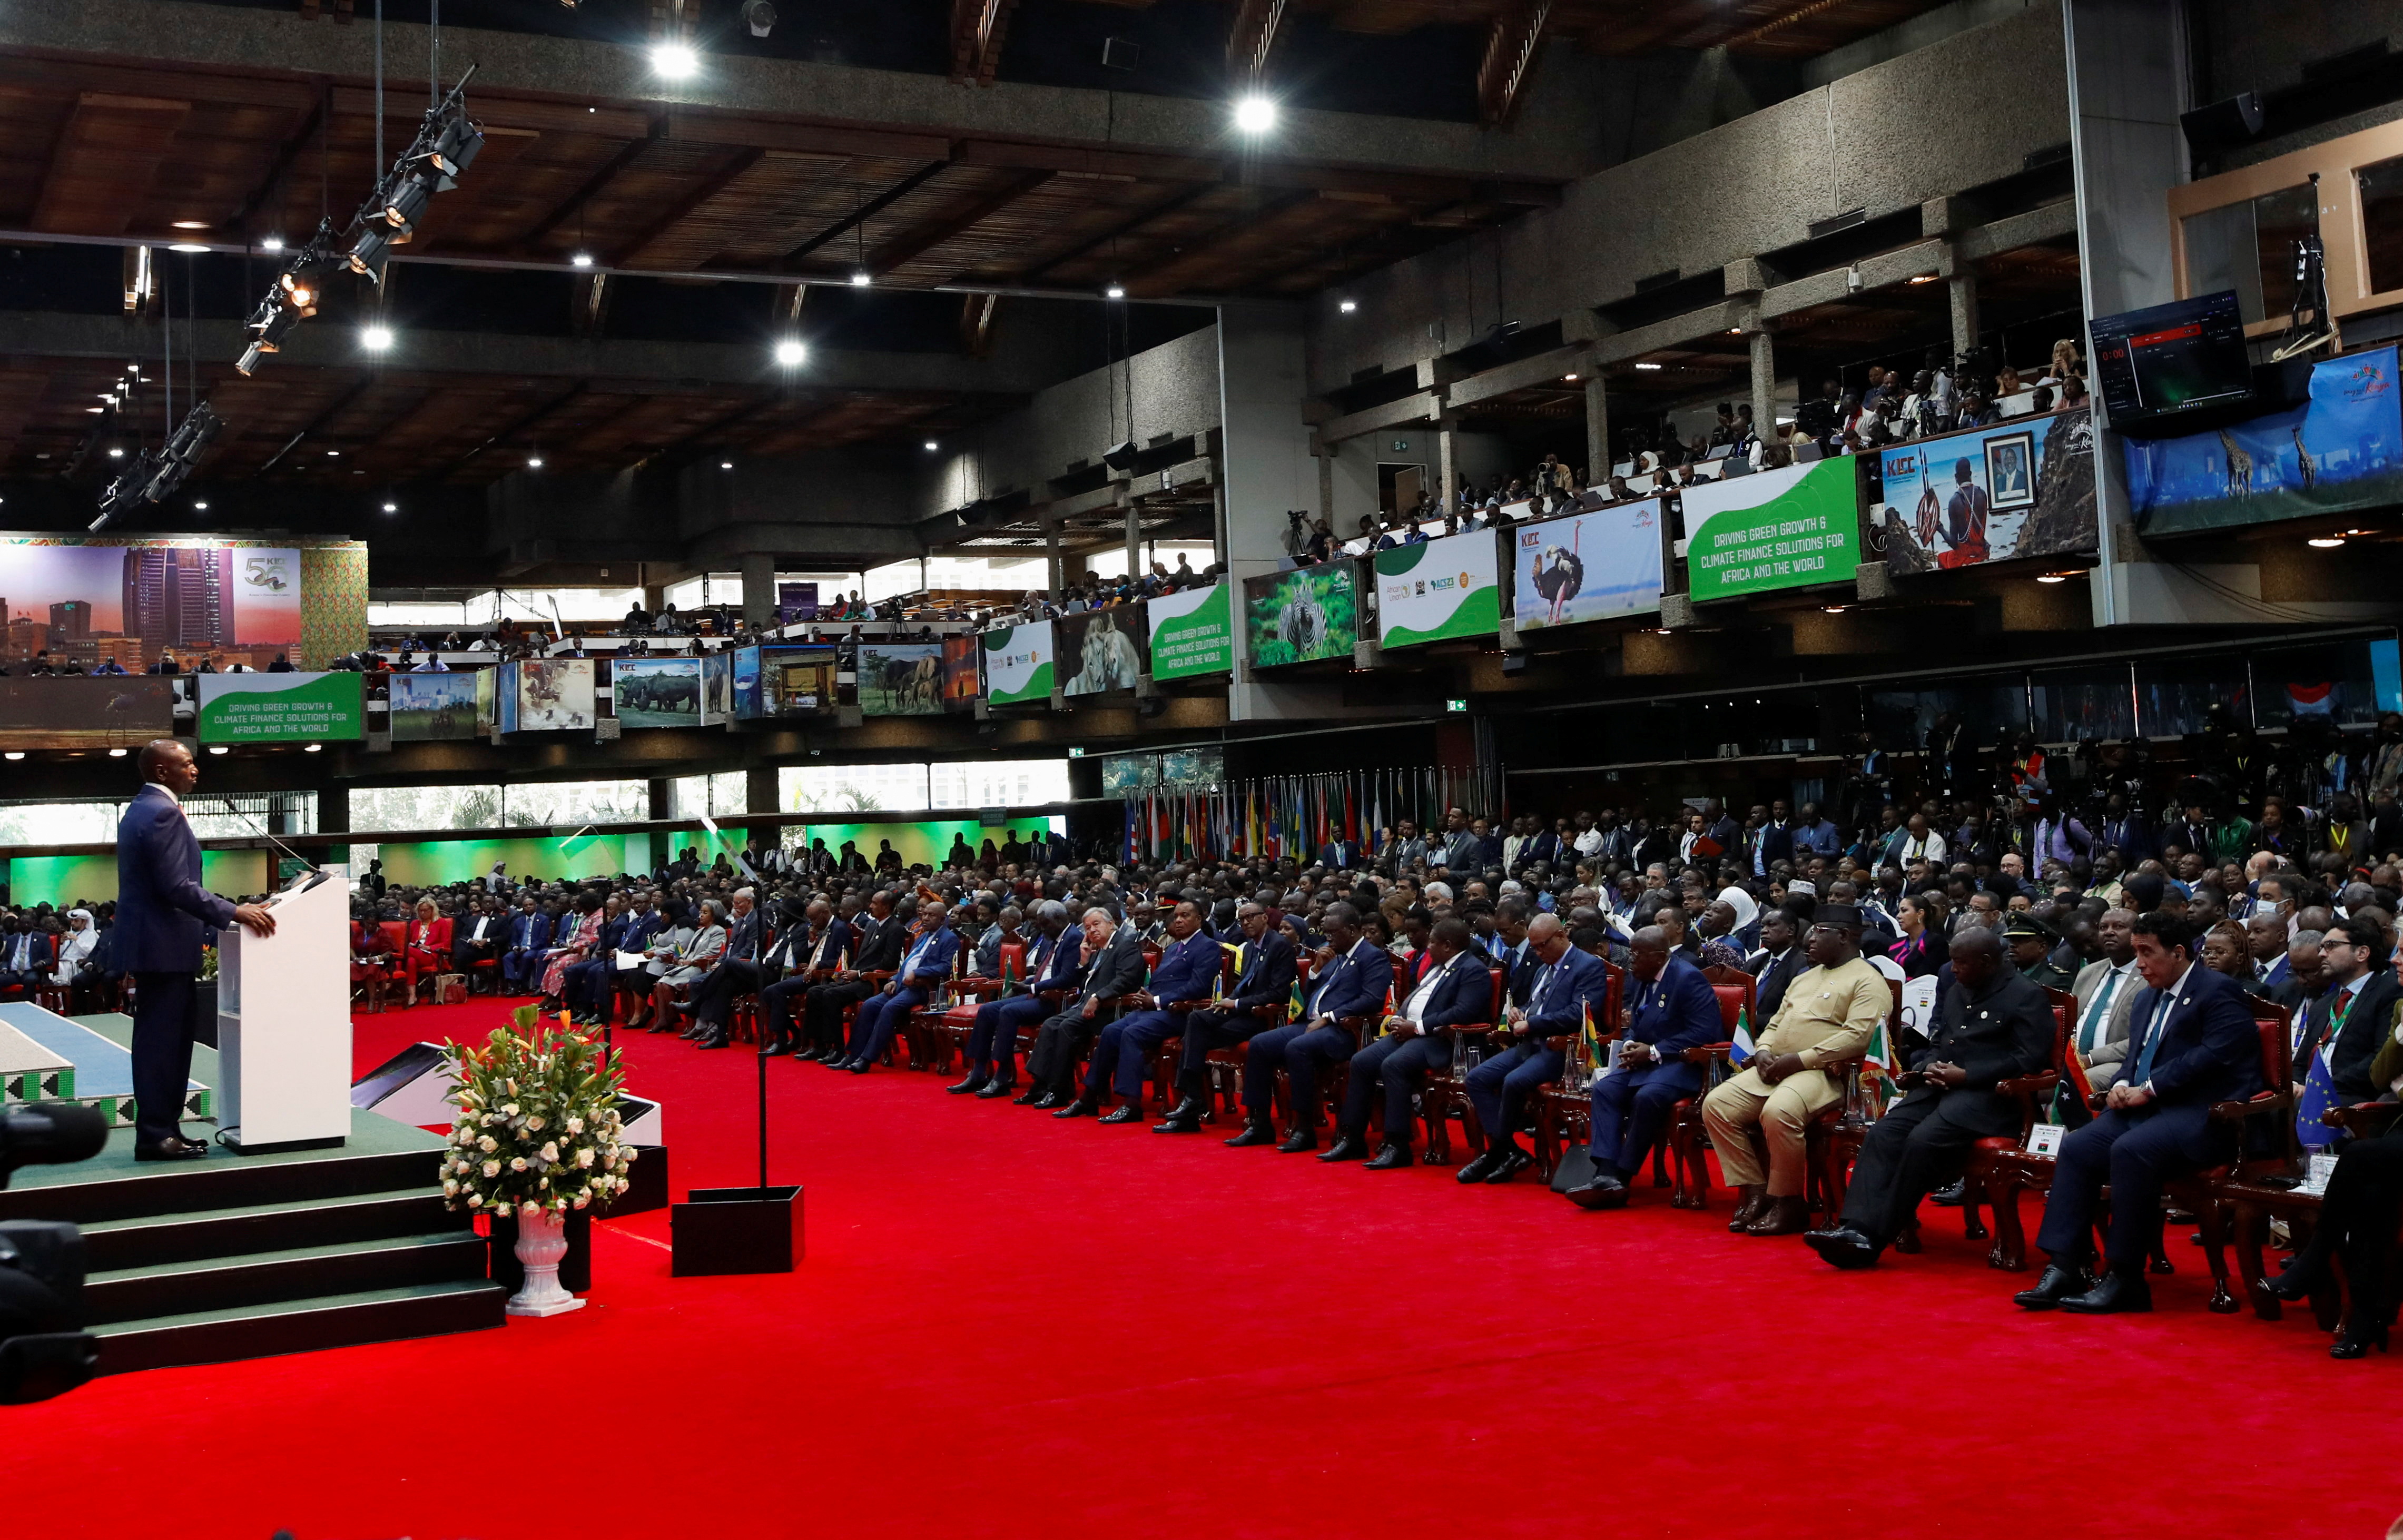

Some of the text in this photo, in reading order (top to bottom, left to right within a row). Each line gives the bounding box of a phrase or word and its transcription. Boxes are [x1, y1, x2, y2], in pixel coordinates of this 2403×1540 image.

[2102, 349, 2124, 361] 0:00
[1887, 456, 1915, 477] KICC
[1521, 531, 1539, 547] KICC
[1714, 516, 1826, 547] DRIVING GREEN GROWTH &
[1701, 533, 1844, 568] CLIMATE FINANCE SOLUTIONS FOR
[1721, 556, 1824, 584] AFRICA AND THE WORLD
[1165, 631, 1181, 643] DRIVING
[1182, 628, 1196, 639] GREEN
[1197, 625, 1216, 637] GROWTH
[1158, 636, 1229, 657] CLIMATE FINANCE SOLUTIONS FOR
[1168, 651, 1220, 669] AFRICA AND THE WORLD
[214, 715, 247, 724] CLIMATE
